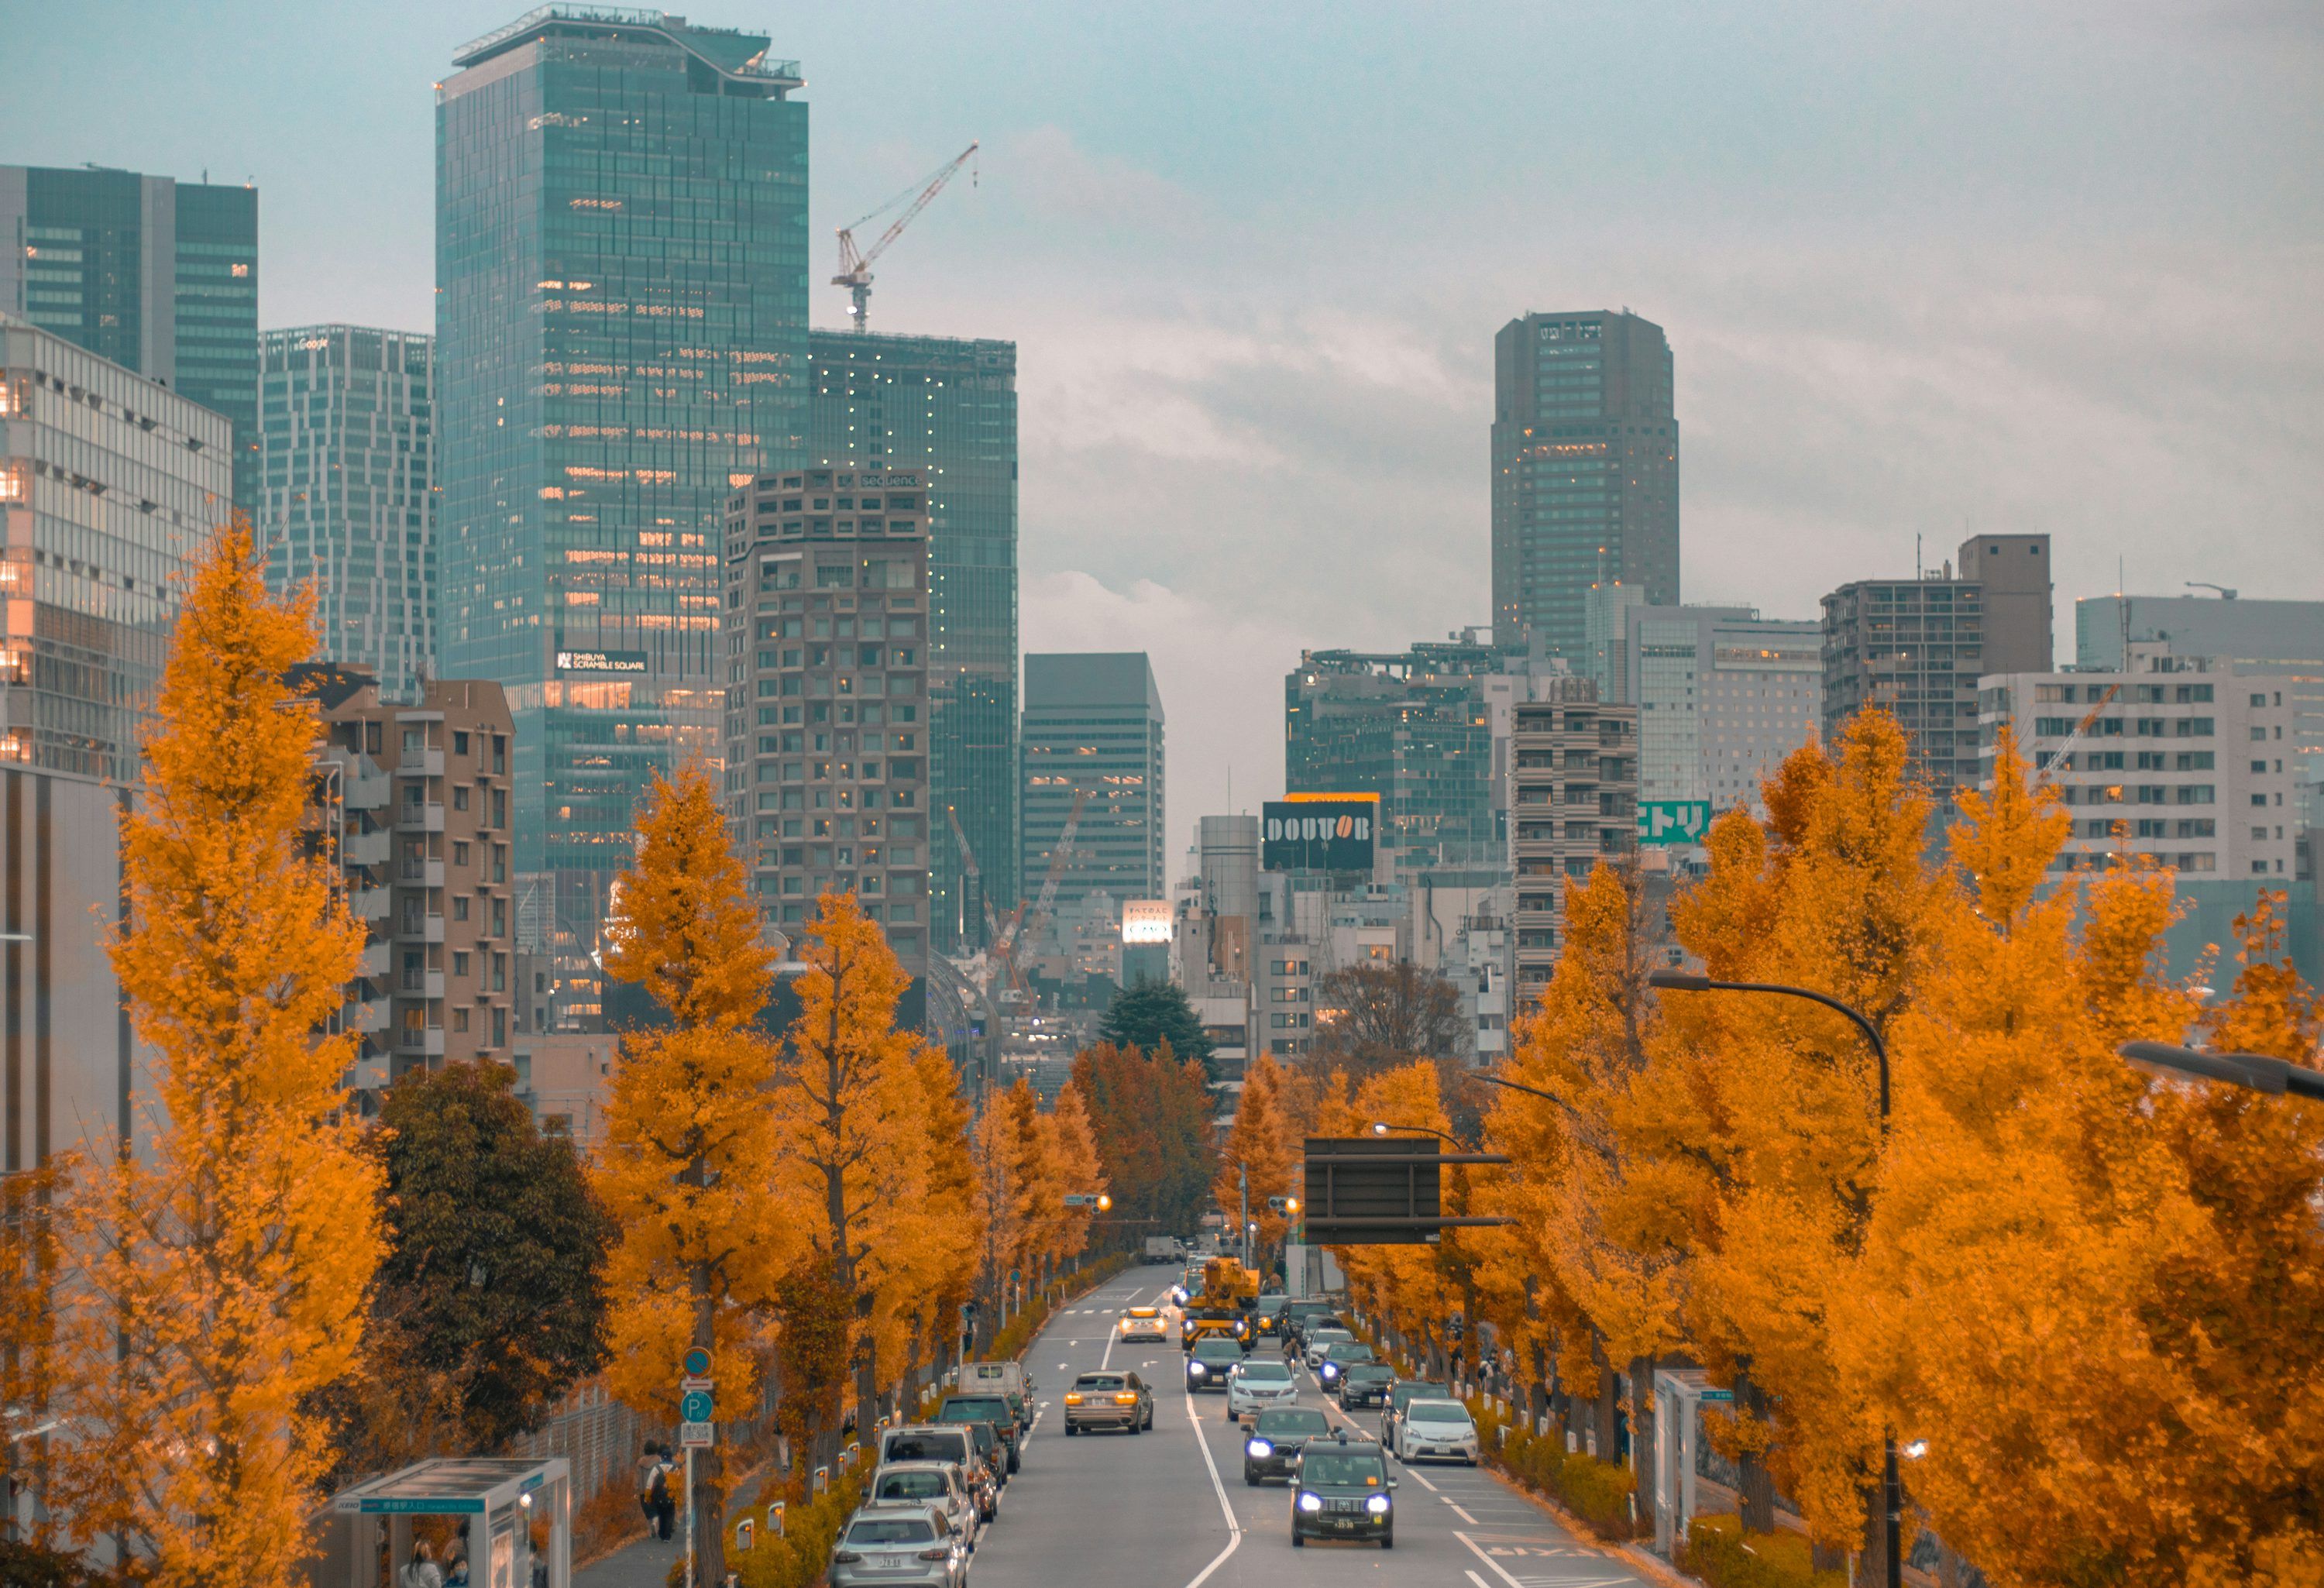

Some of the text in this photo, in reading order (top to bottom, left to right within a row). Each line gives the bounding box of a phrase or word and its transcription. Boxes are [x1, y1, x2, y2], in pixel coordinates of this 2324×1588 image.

[299, 337, 328, 351] Google
[861, 476, 923, 487] sequence
[573, 661, 645, 670] SCRAMBLE SQUARE
[1267, 815, 1370, 841] DOUTOR
[688, 1398, 701, 1418] P
